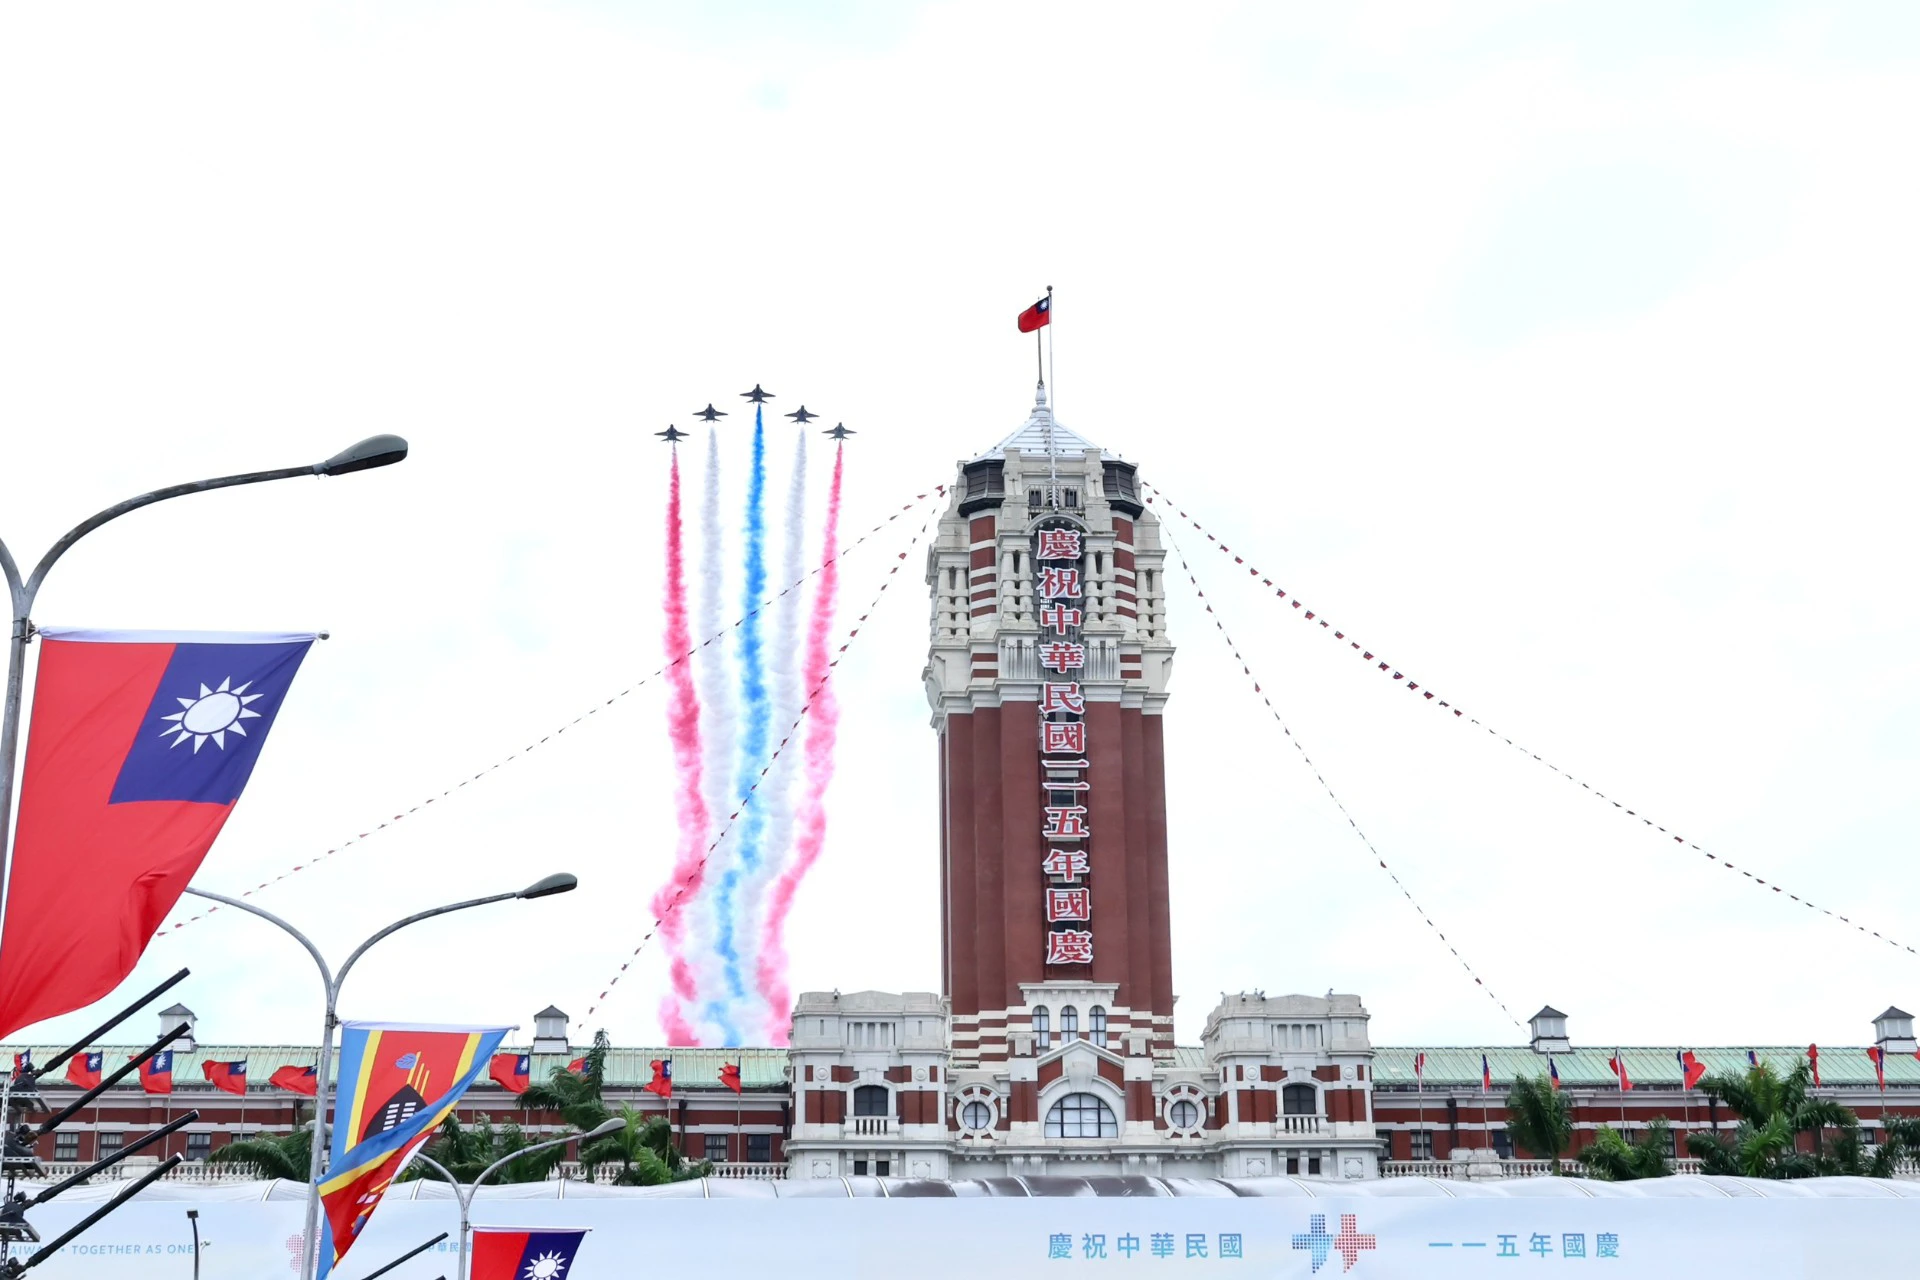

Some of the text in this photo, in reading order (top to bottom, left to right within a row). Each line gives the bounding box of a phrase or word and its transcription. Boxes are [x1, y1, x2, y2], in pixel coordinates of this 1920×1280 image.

[1036, 528, 1094, 965] 慶祝中華民國一一五年國慶
[9, 1244, 194, 1255] AIW TOGETHER AS ONE
[1048, 1232, 1620, 1259] 慶祝中華民國 一一五年國慶
